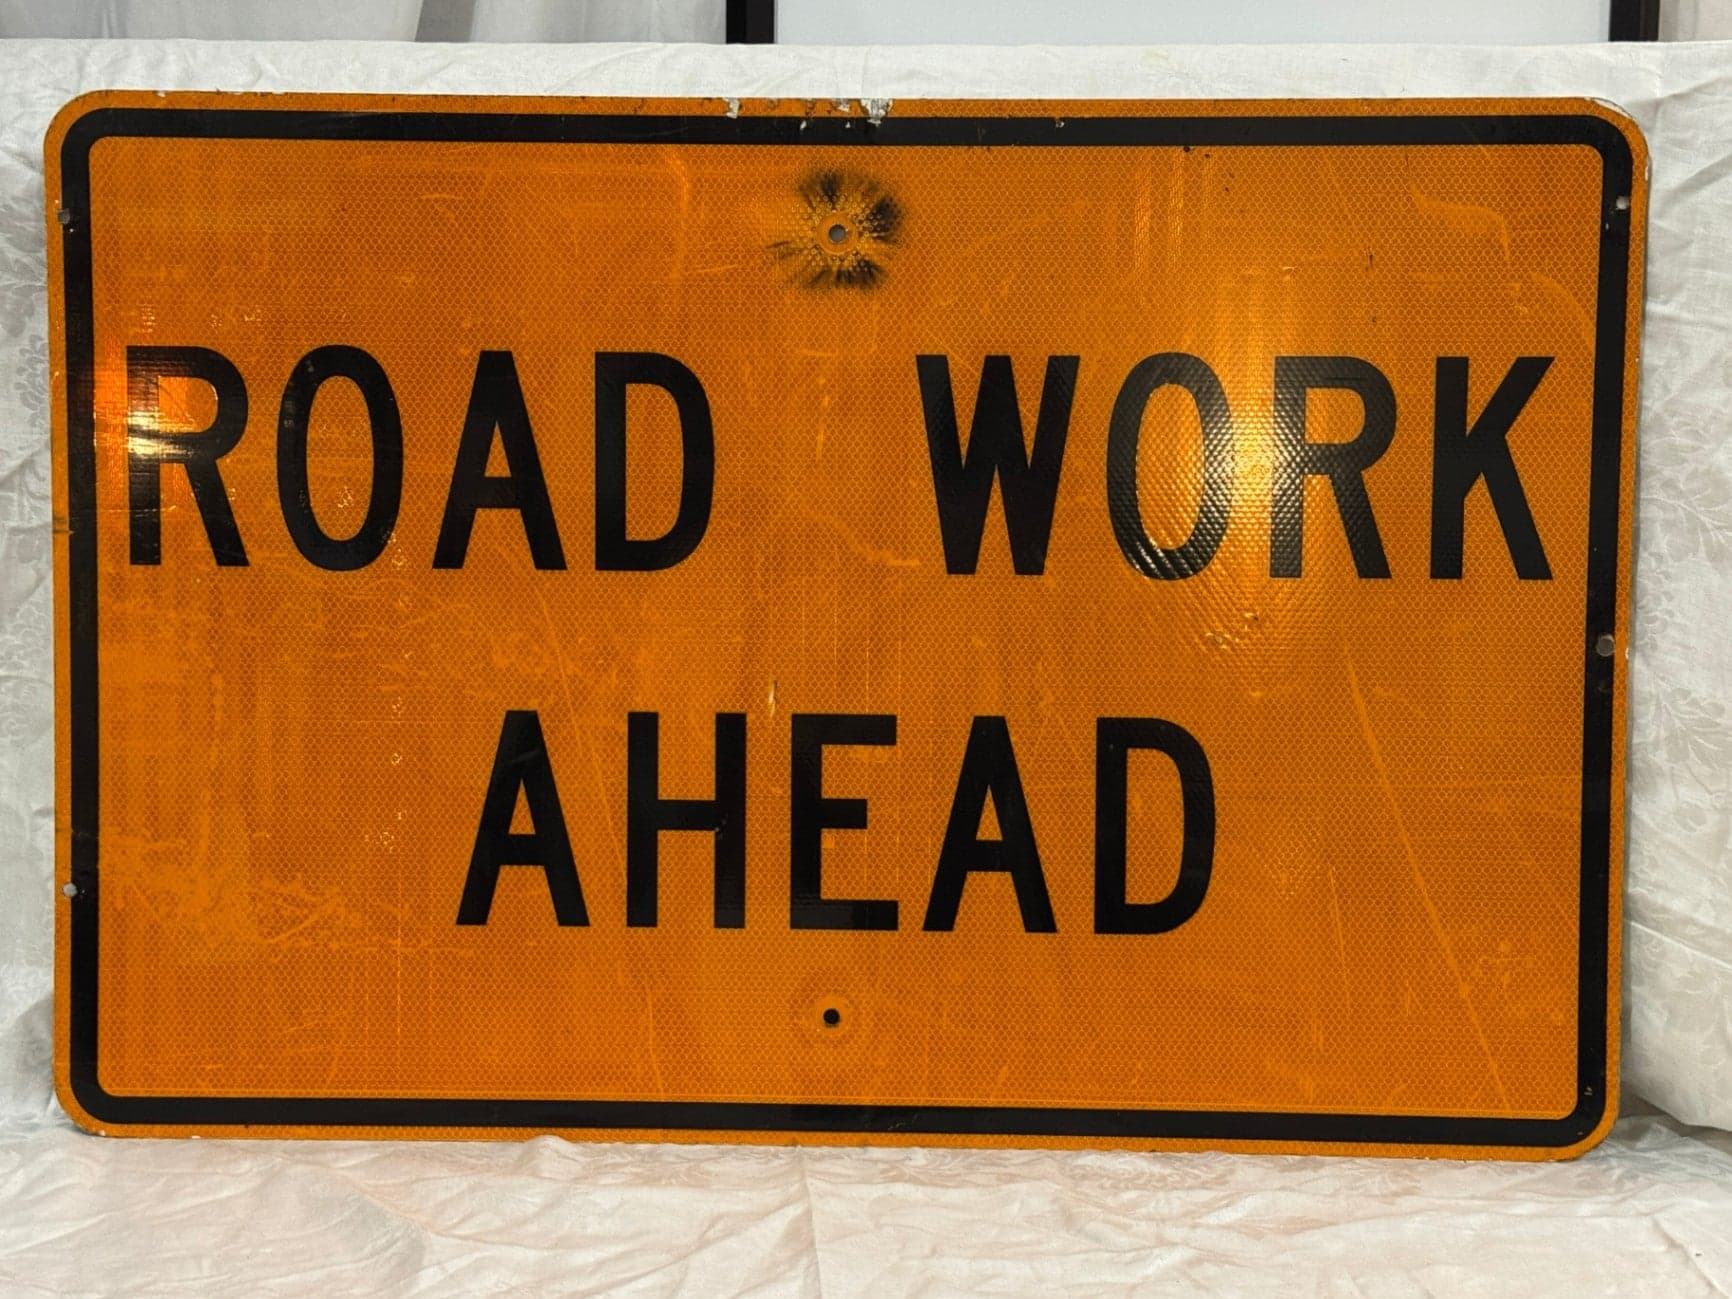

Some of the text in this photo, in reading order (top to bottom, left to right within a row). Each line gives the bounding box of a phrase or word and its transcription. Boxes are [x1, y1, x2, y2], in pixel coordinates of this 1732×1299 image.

[126, 344, 1555, 581] ROAD WORK
[456, 710, 1217, 935] AHEAD
